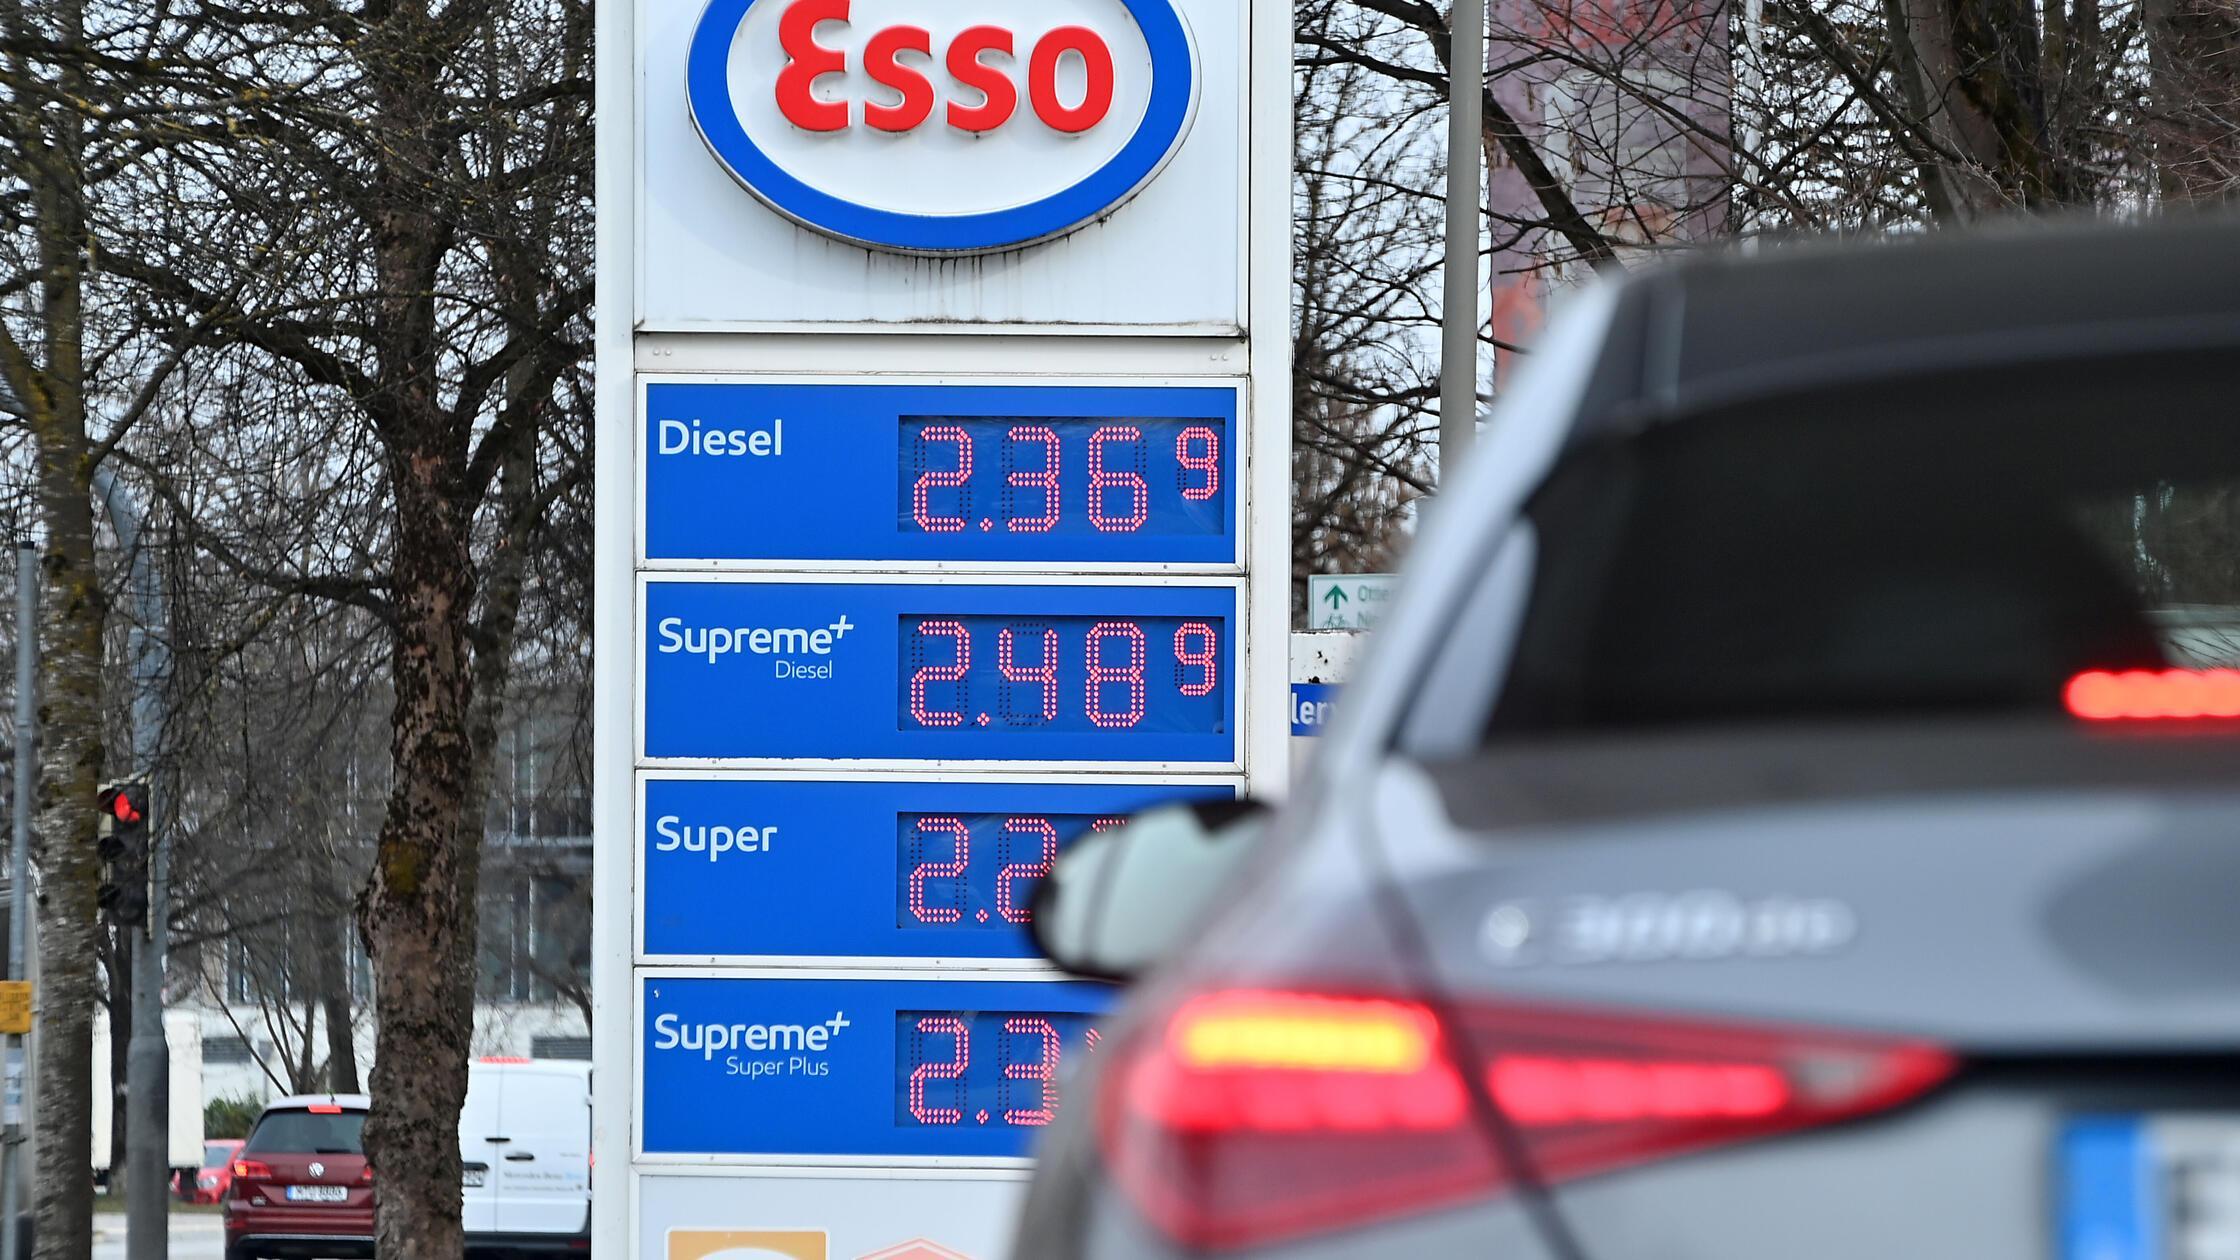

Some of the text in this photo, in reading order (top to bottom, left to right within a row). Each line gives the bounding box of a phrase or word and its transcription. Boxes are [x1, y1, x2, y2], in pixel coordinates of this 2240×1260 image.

[774, 0, 1114, 133] Esso
[657, 418, 783, 456] Diesel
[774, 659, 833, 680] Diesel
[1291, 692, 1337, 726] ler
[655, 815, 778, 862] Super
[909, 816, 1127, 924] 2.2
[725, 1056, 830, 1081] Super Plus
[909, 1017, 1103, 1127] 2.3
